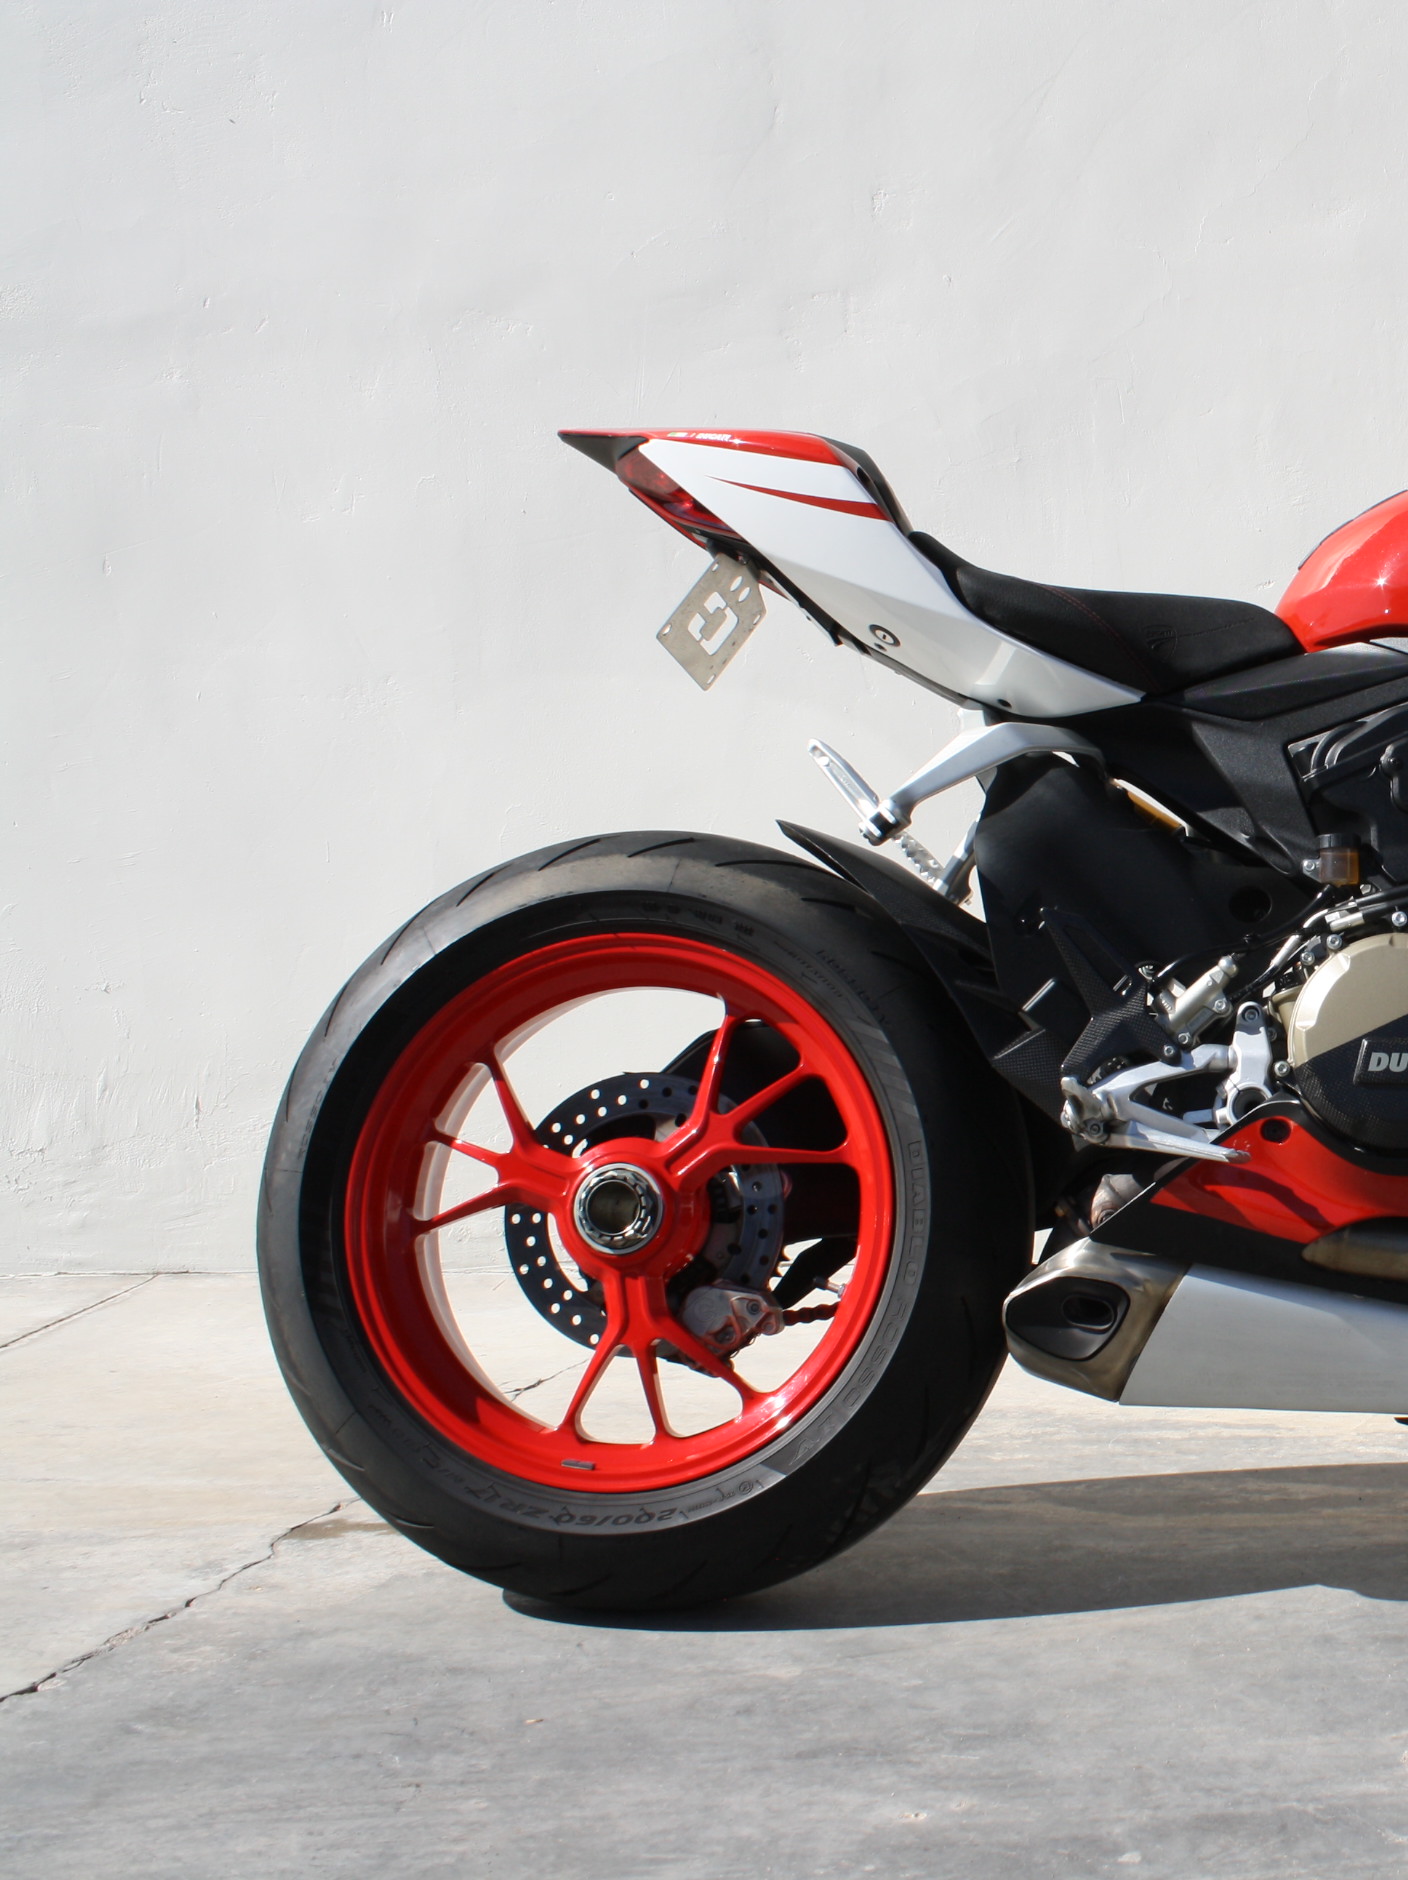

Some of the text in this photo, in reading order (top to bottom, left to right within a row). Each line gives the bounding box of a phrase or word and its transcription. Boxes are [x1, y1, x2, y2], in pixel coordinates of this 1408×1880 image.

[901, 1141, 927, 1289] DIABLO
[844, 1298, 908, 1409] ROSSO
[552, 1507, 679, 1527] 200/60
